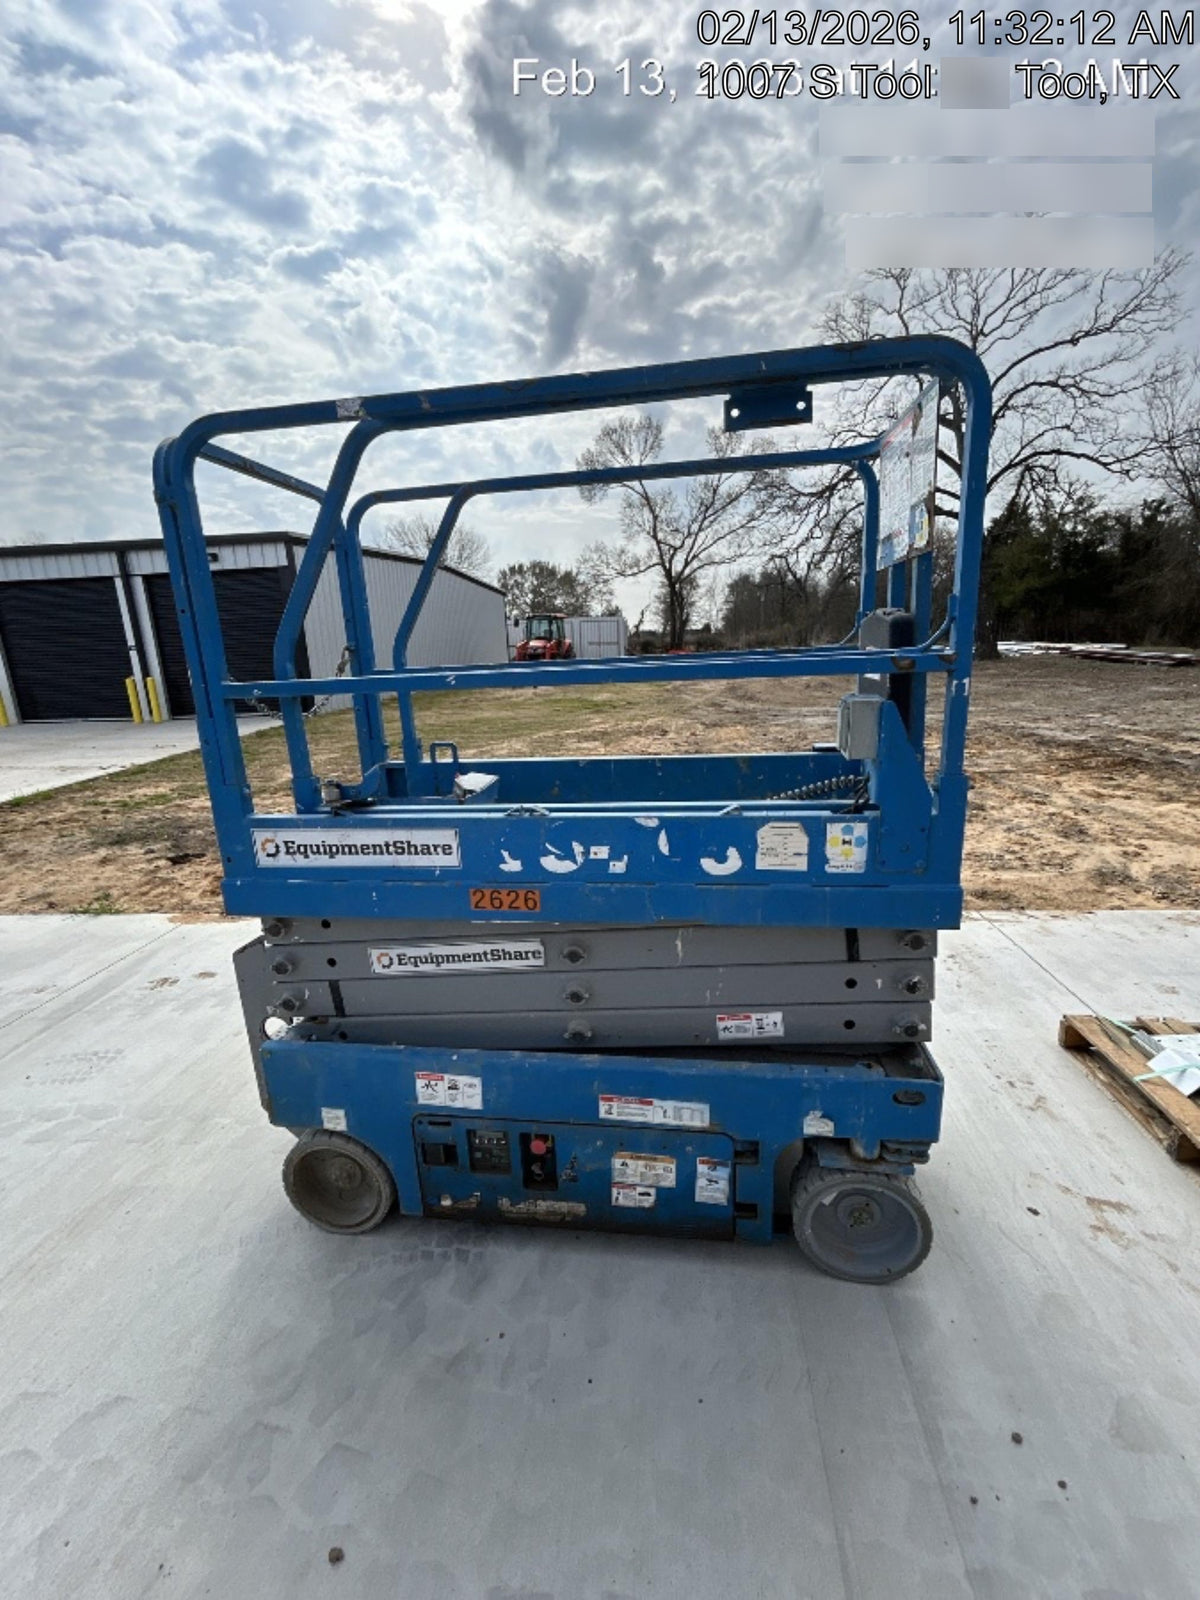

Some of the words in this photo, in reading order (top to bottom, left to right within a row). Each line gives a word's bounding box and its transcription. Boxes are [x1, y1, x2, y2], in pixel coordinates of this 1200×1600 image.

[282, 839, 454, 860] EquipmentShare
[472, 888, 539, 911] 2626
[396, 947, 543, 968] EquipmentShare
